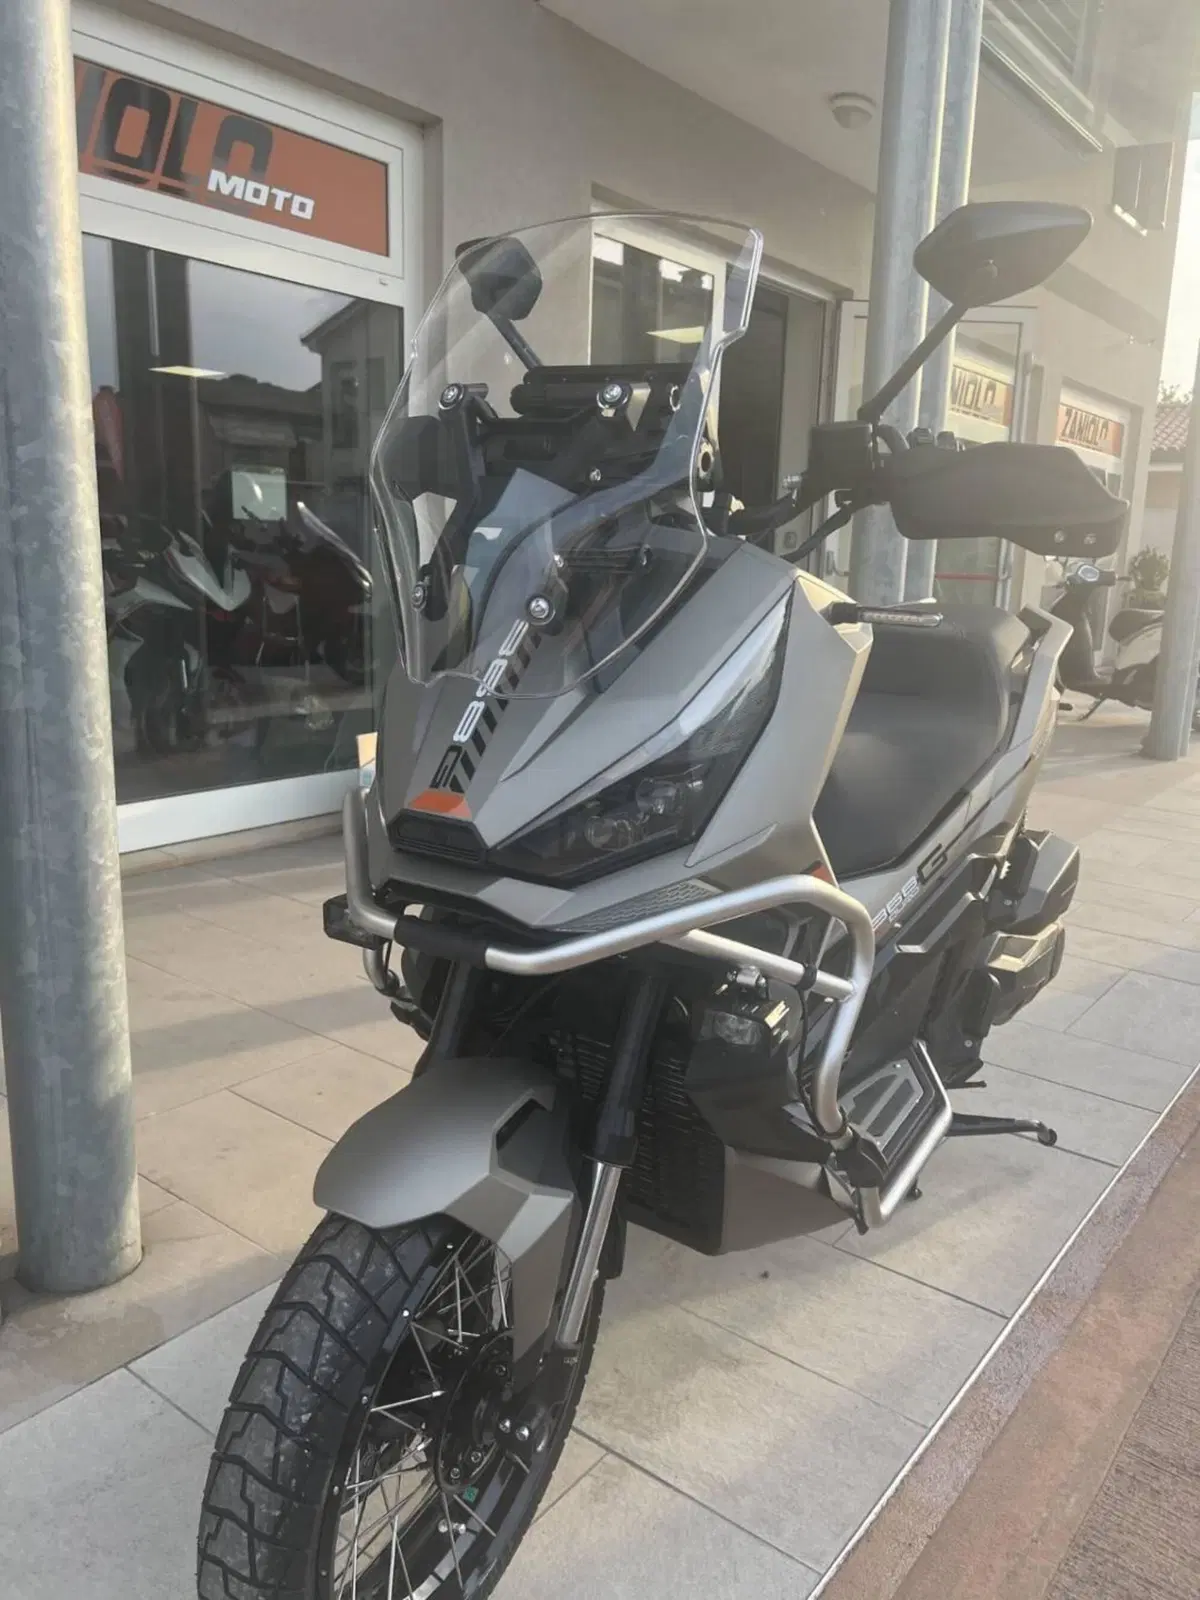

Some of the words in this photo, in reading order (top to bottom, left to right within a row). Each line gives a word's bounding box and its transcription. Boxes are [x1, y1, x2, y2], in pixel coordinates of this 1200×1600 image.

[75, 63, 274, 184] IOLO
[207, 168, 316, 220] MOTO
[1061, 407, 1110, 446] ZANIOLO
